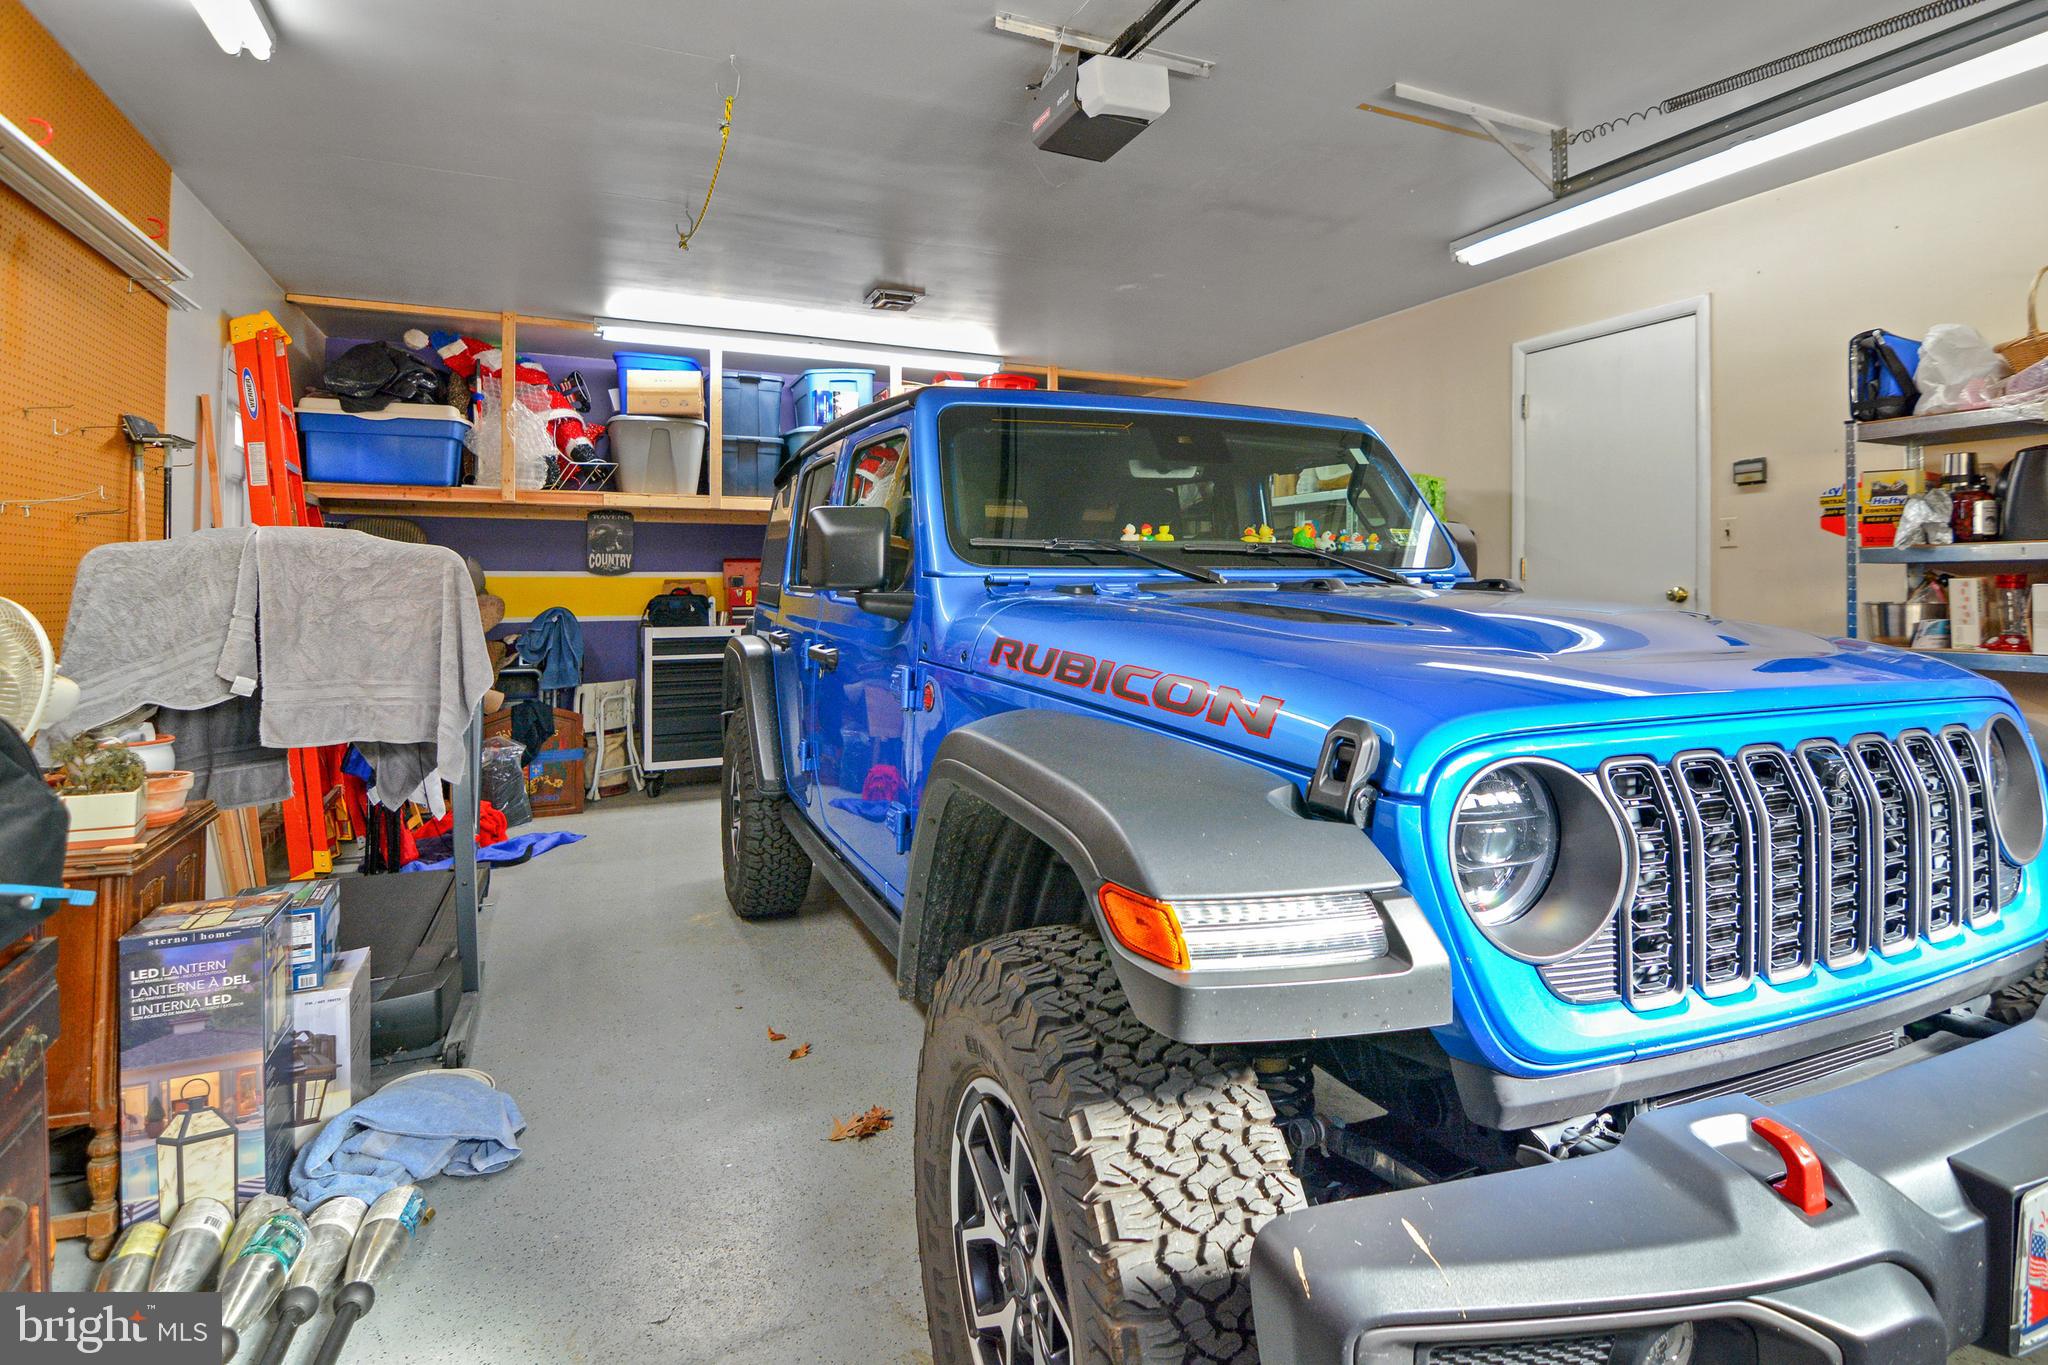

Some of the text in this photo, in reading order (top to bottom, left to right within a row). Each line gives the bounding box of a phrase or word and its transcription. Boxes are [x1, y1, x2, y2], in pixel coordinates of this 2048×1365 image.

[245, 378, 256, 409] WERNER
[1872, 496, 1905, 505] Hefty
[588, 553, 632, 569] COUNTRY
[989, 636, 1286, 739] RUBICON
[148, 931, 232, 946] sterno home
[130, 959, 226, 981] LED LANTERN
[131, 979, 205, 999] LANTERNE
[208, 976, 219, 988] À
[222, 974, 250, 987] DEL
[131, 994, 232, 1017] LINTERNA LED
